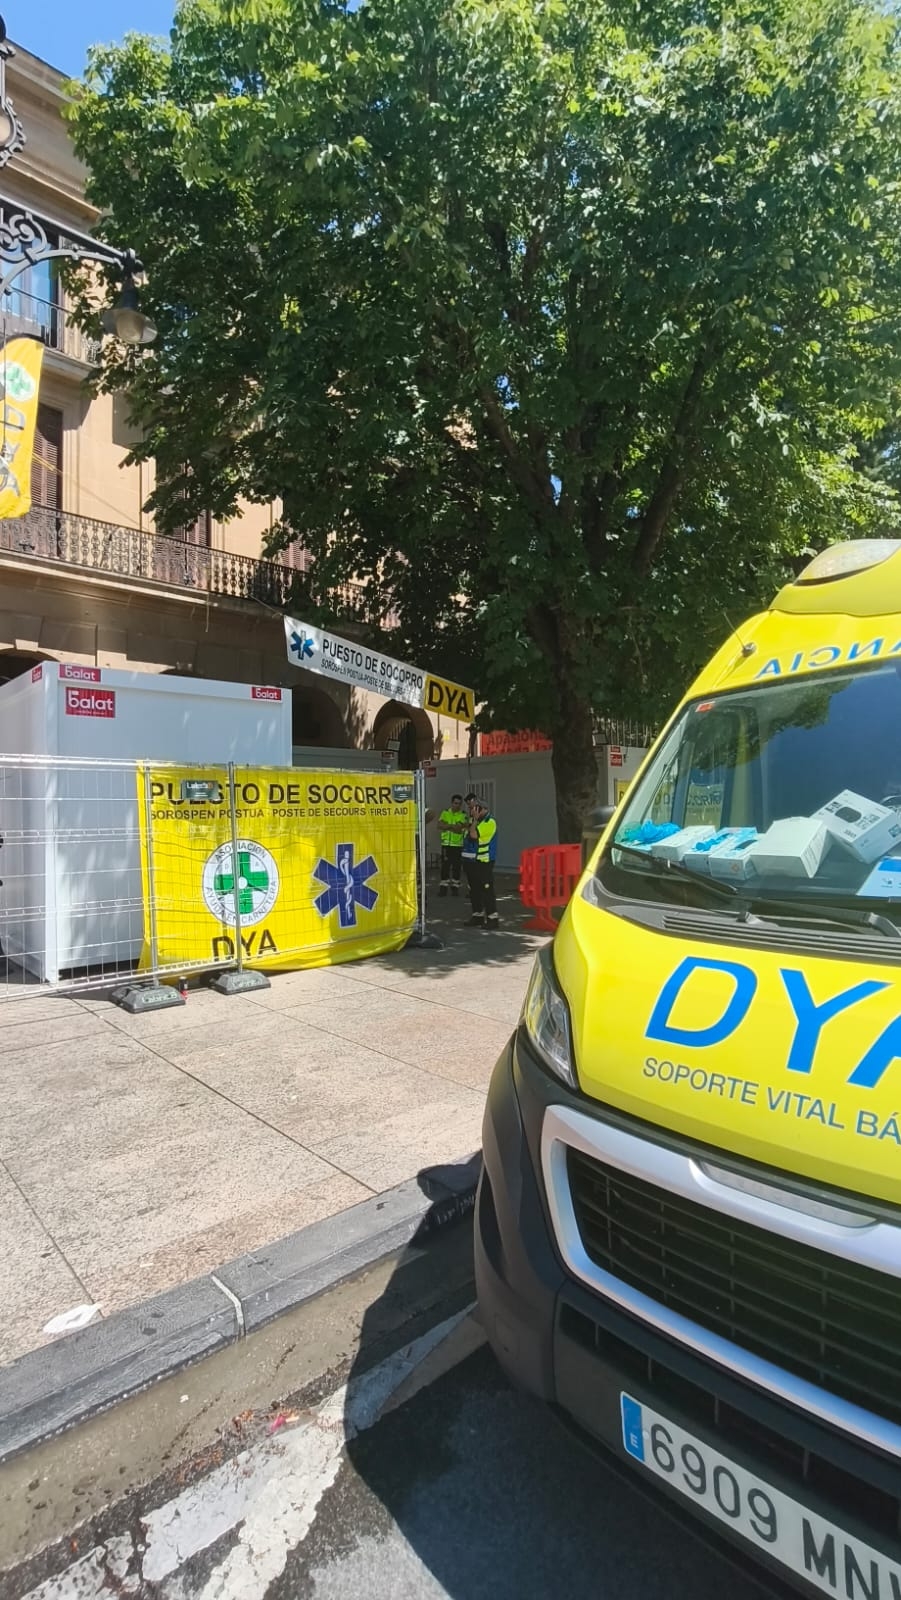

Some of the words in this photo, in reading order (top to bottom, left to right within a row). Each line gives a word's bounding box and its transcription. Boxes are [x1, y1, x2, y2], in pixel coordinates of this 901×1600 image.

[65, 666, 96, 682] balat
[322, 639, 363, 667] PUESTO
[364, 655, 378, 672] DE
[379, 662, 424, 690] SOCORRO
[68, 690, 113, 711] balat
[255, 688, 278, 700] balat
[427, 680, 470, 718] DYA
[269, 784, 301, 804] DE
[151, 809, 216, 820] SOROSPEN
[272, 808, 305, 818] POSTE
[308, 808, 320, 817] DE
[323, 807, 366, 817] SECOURS
[370, 807, 391, 816] FIRST
[393, 807, 408, 816] AID
[214, 842, 268, 863] ASOIACION
[212, 929, 278, 962] DYA
[643, 1057, 759, 1104] SOPORTE
[767, 1087, 845, 1129] VITAL
[630, 1433, 639, 1449] E
[651, 1423, 777, 1543] 6909
